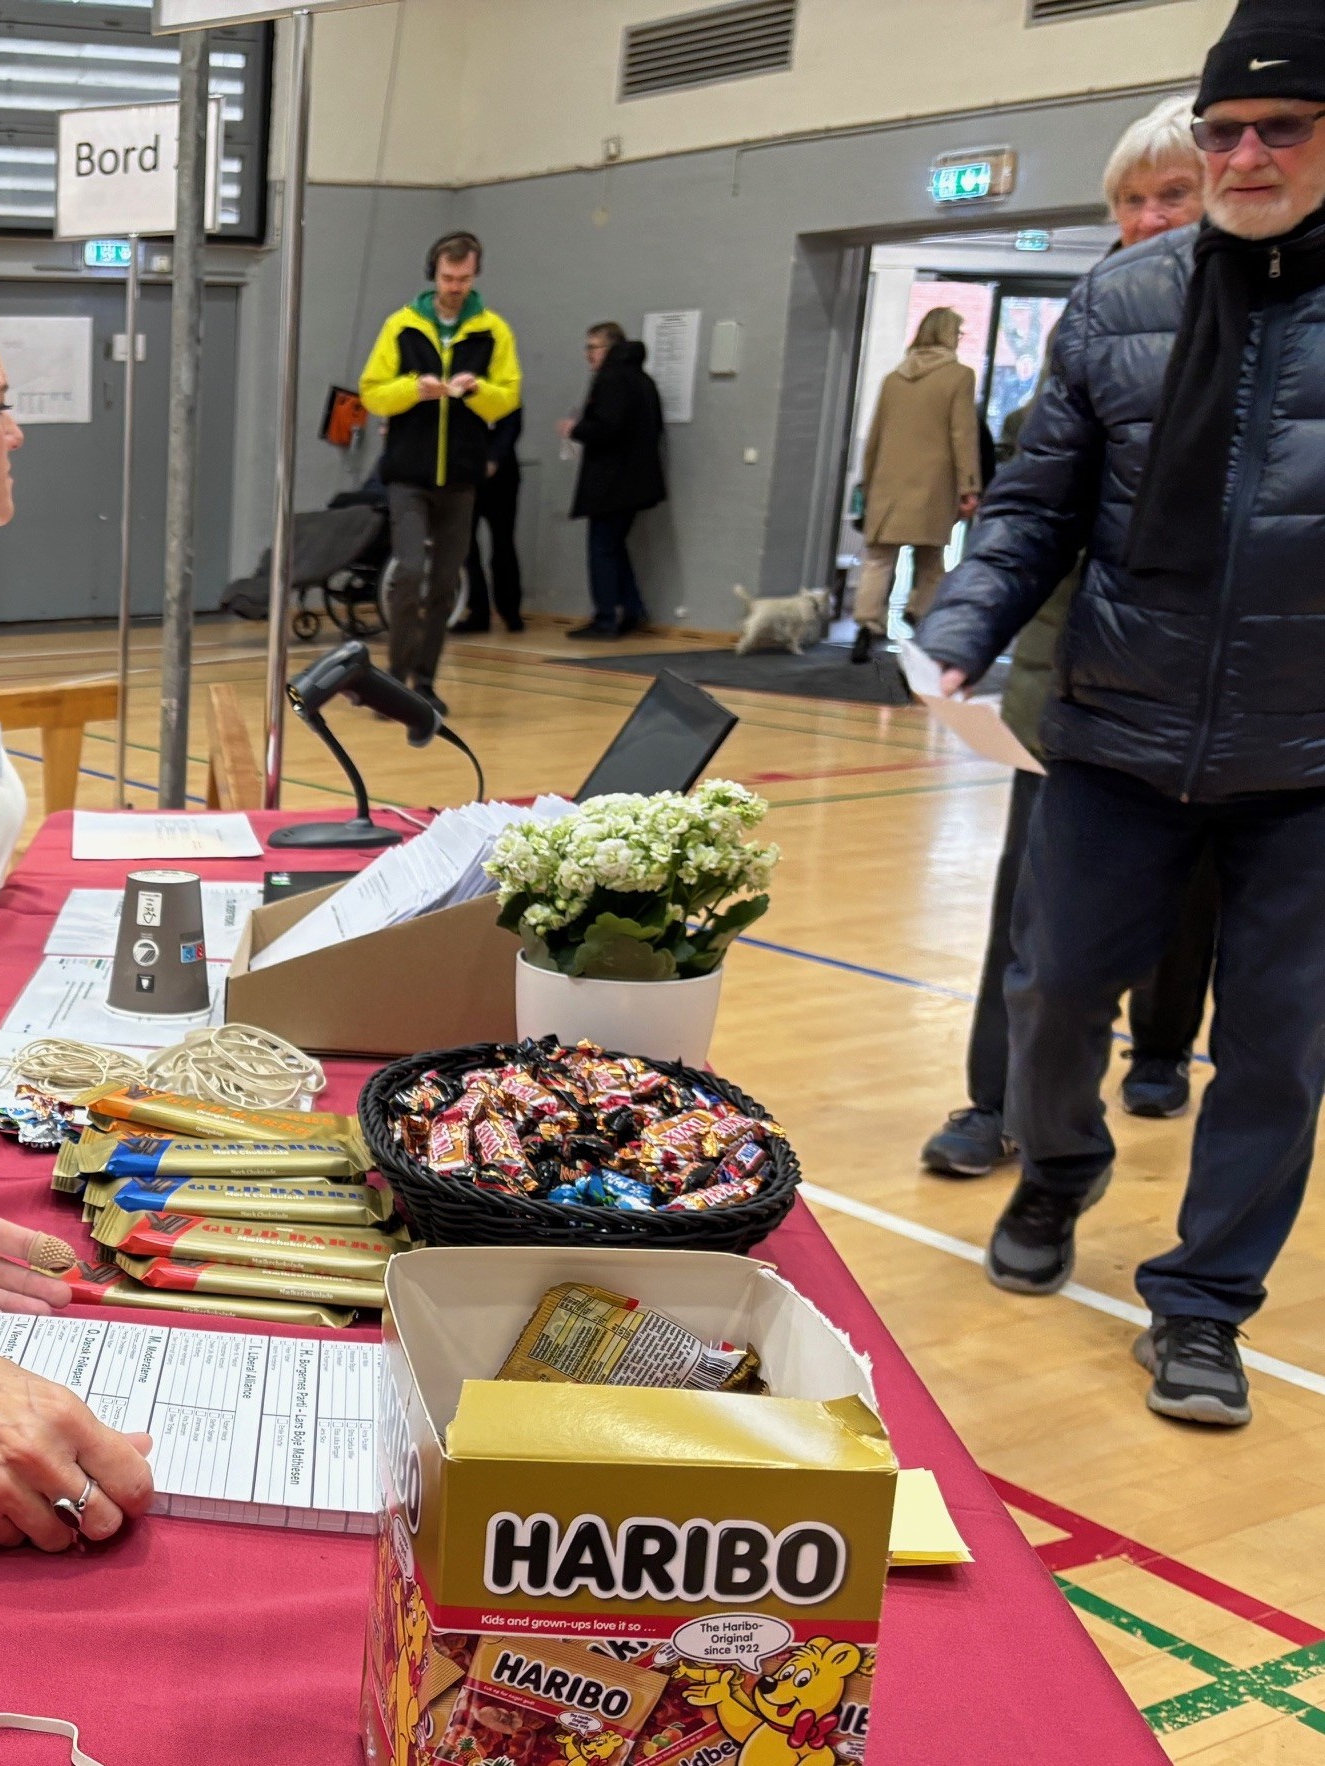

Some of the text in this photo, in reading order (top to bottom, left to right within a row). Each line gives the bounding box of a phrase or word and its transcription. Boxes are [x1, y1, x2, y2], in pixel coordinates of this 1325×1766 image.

[75, 133, 161, 177] Bord
[202, 1224, 280, 1239] GULD
[80, 1337, 96, 1355] Dansk
[300, 1349, 312, 1358] H.
[139, 1335, 162, 1383] M. Moderaterne
[245, 1351, 261, 1373] Liberal
[70, 1356, 90, 1386] Folkeparti
[295, 1359, 310, 1390] Borgernes
[242, 1373, 258, 1399] Alliance
[295, 1391, 307, 1408] Parti
[294, 1414, 305, 1428] Lars
[291, 1430, 305, 1446] Boje
[290, 1447, 304, 1485] Mathiesen
[487, 1514, 843, 1601] HARIBO
[480, 1614, 505, 1627] Kids
[506, 1615, 529, 1627] and
[530, 1617, 591, 1631] grown-ups
[592, 1619, 616, 1631] love
[617, 1620, 627, 1631] it
[627, 1622, 641, 1632] so
[700, 1622, 764, 1633] The Haribo-
[711, 1633, 753, 1645] Original
[704, 1644, 760, 1656] since 1922
[492, 1652, 630, 1718] HARIBO
